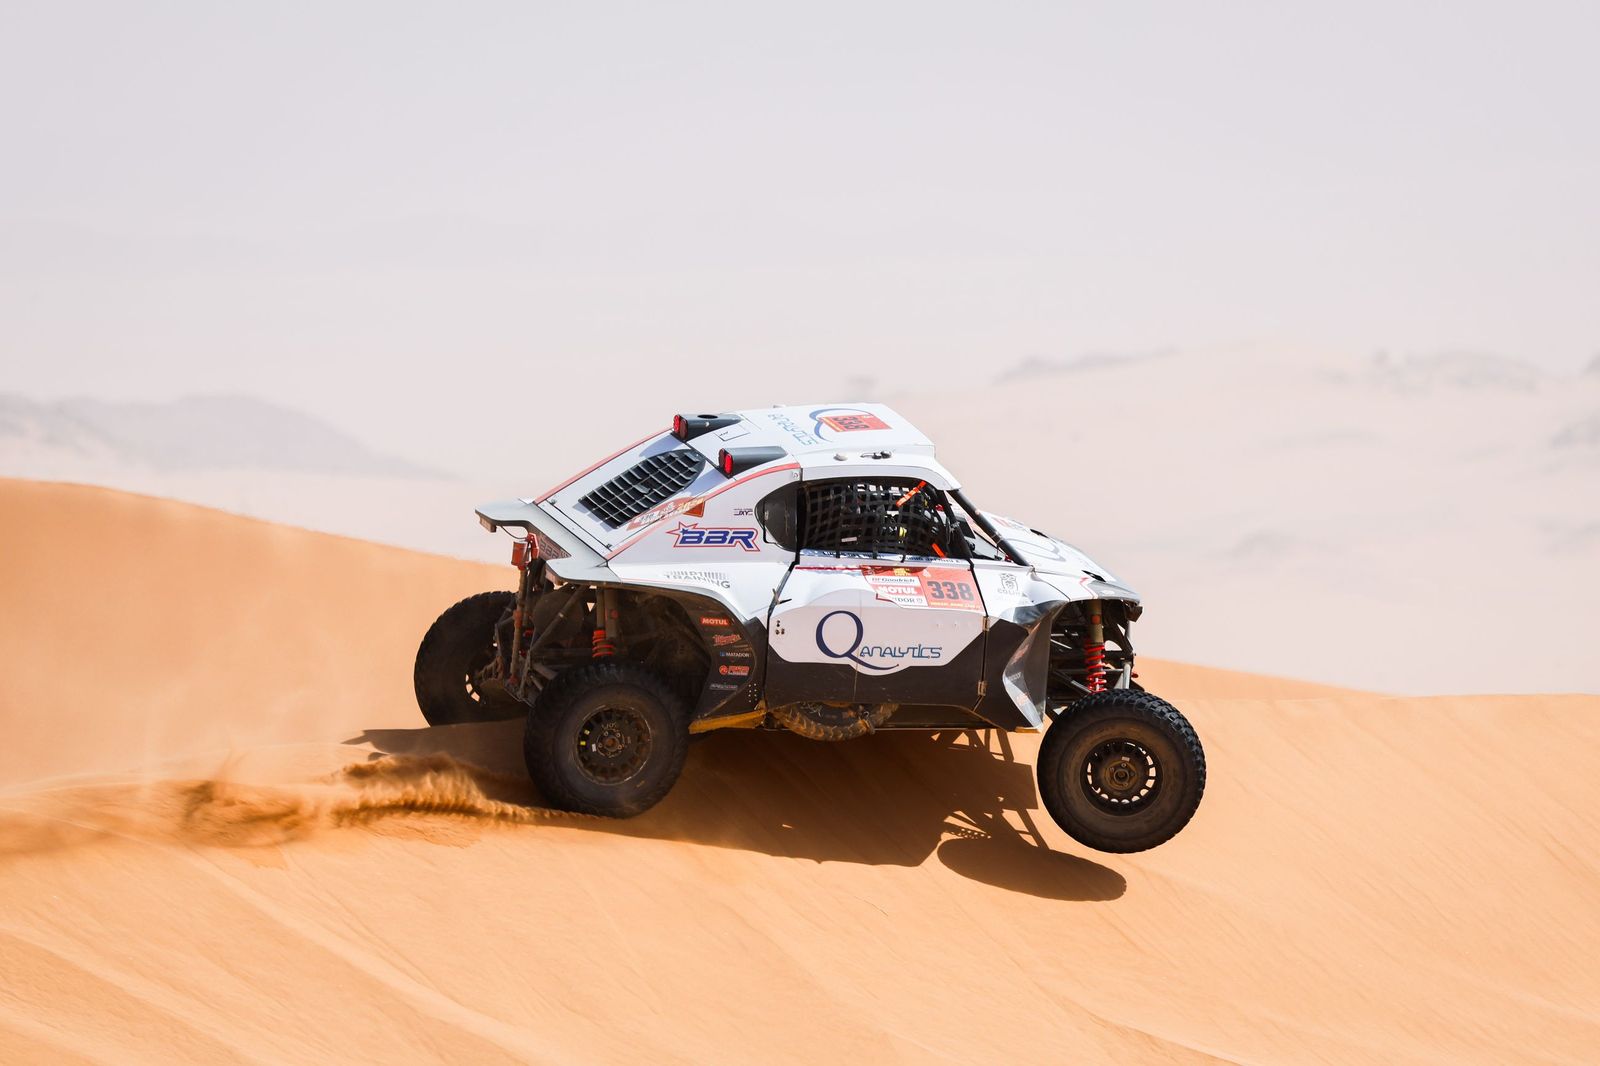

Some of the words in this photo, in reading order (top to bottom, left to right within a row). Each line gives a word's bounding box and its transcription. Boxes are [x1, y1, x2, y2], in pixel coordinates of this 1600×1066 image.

[678, 529, 755, 549] BBR
[664, 573, 731, 589] TRAINING
[878, 585, 918, 595] MOTUL
[927, 580, 975, 601] 338
[702, 617, 729, 626] MOTUL
